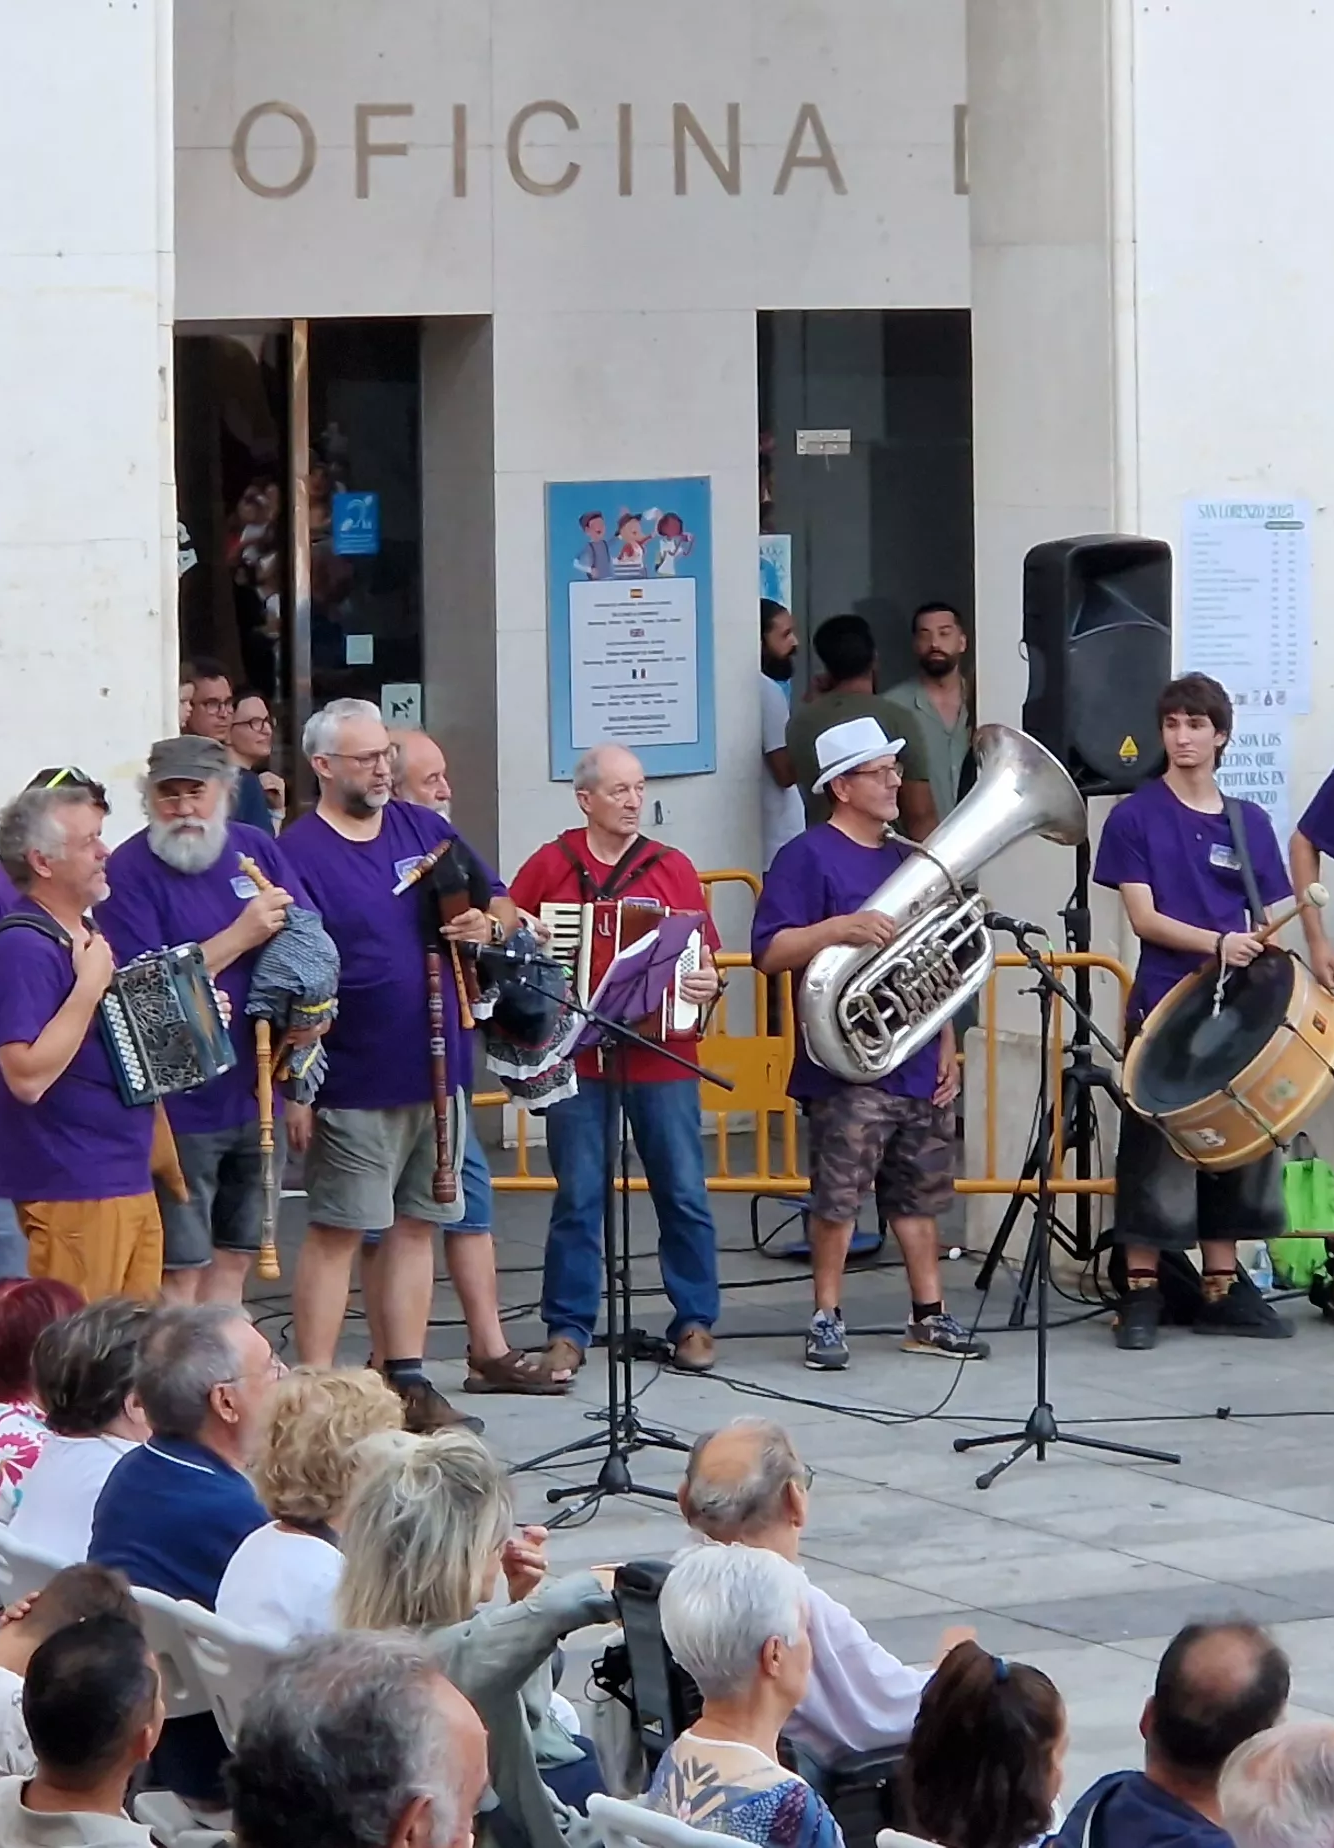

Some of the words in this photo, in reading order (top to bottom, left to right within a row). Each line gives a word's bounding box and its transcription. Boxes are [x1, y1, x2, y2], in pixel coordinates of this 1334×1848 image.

[230, 99, 848, 200] OFICINA
[1239, 733, 1259, 747] SON
[1262, 733, 1282, 746] LOS
[1222, 753, 1252, 767] ECIOS
[1255, 752, 1275, 768] QUE
[1271, 771, 1285, 785] EN
